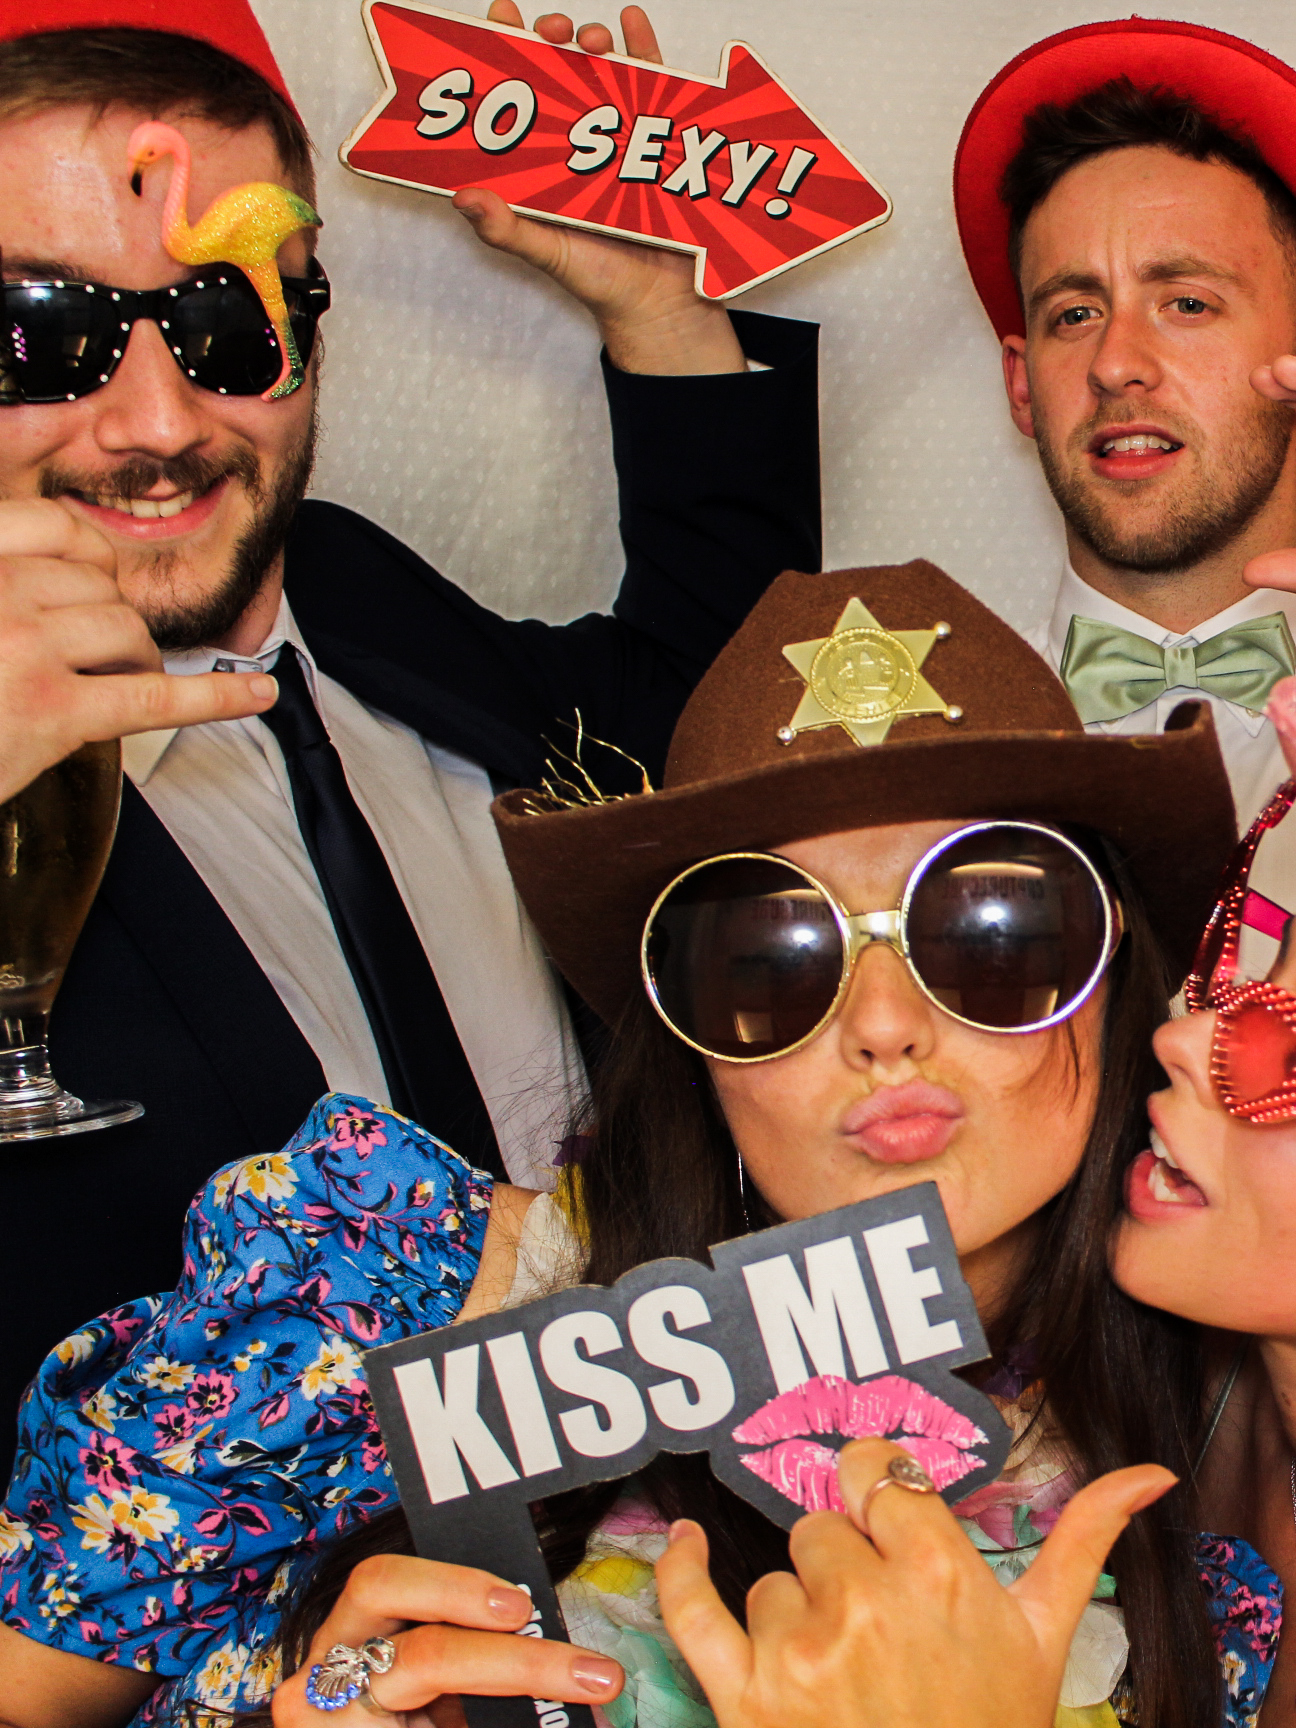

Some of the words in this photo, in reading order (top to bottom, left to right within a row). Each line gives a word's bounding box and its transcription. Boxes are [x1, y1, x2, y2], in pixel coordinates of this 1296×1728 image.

[415, 68, 538, 153] SO
[566, 105, 816, 220] SEXY!
[392, 1284, 736, 1505] KISS
[742, 1214, 964, 1394] ME
